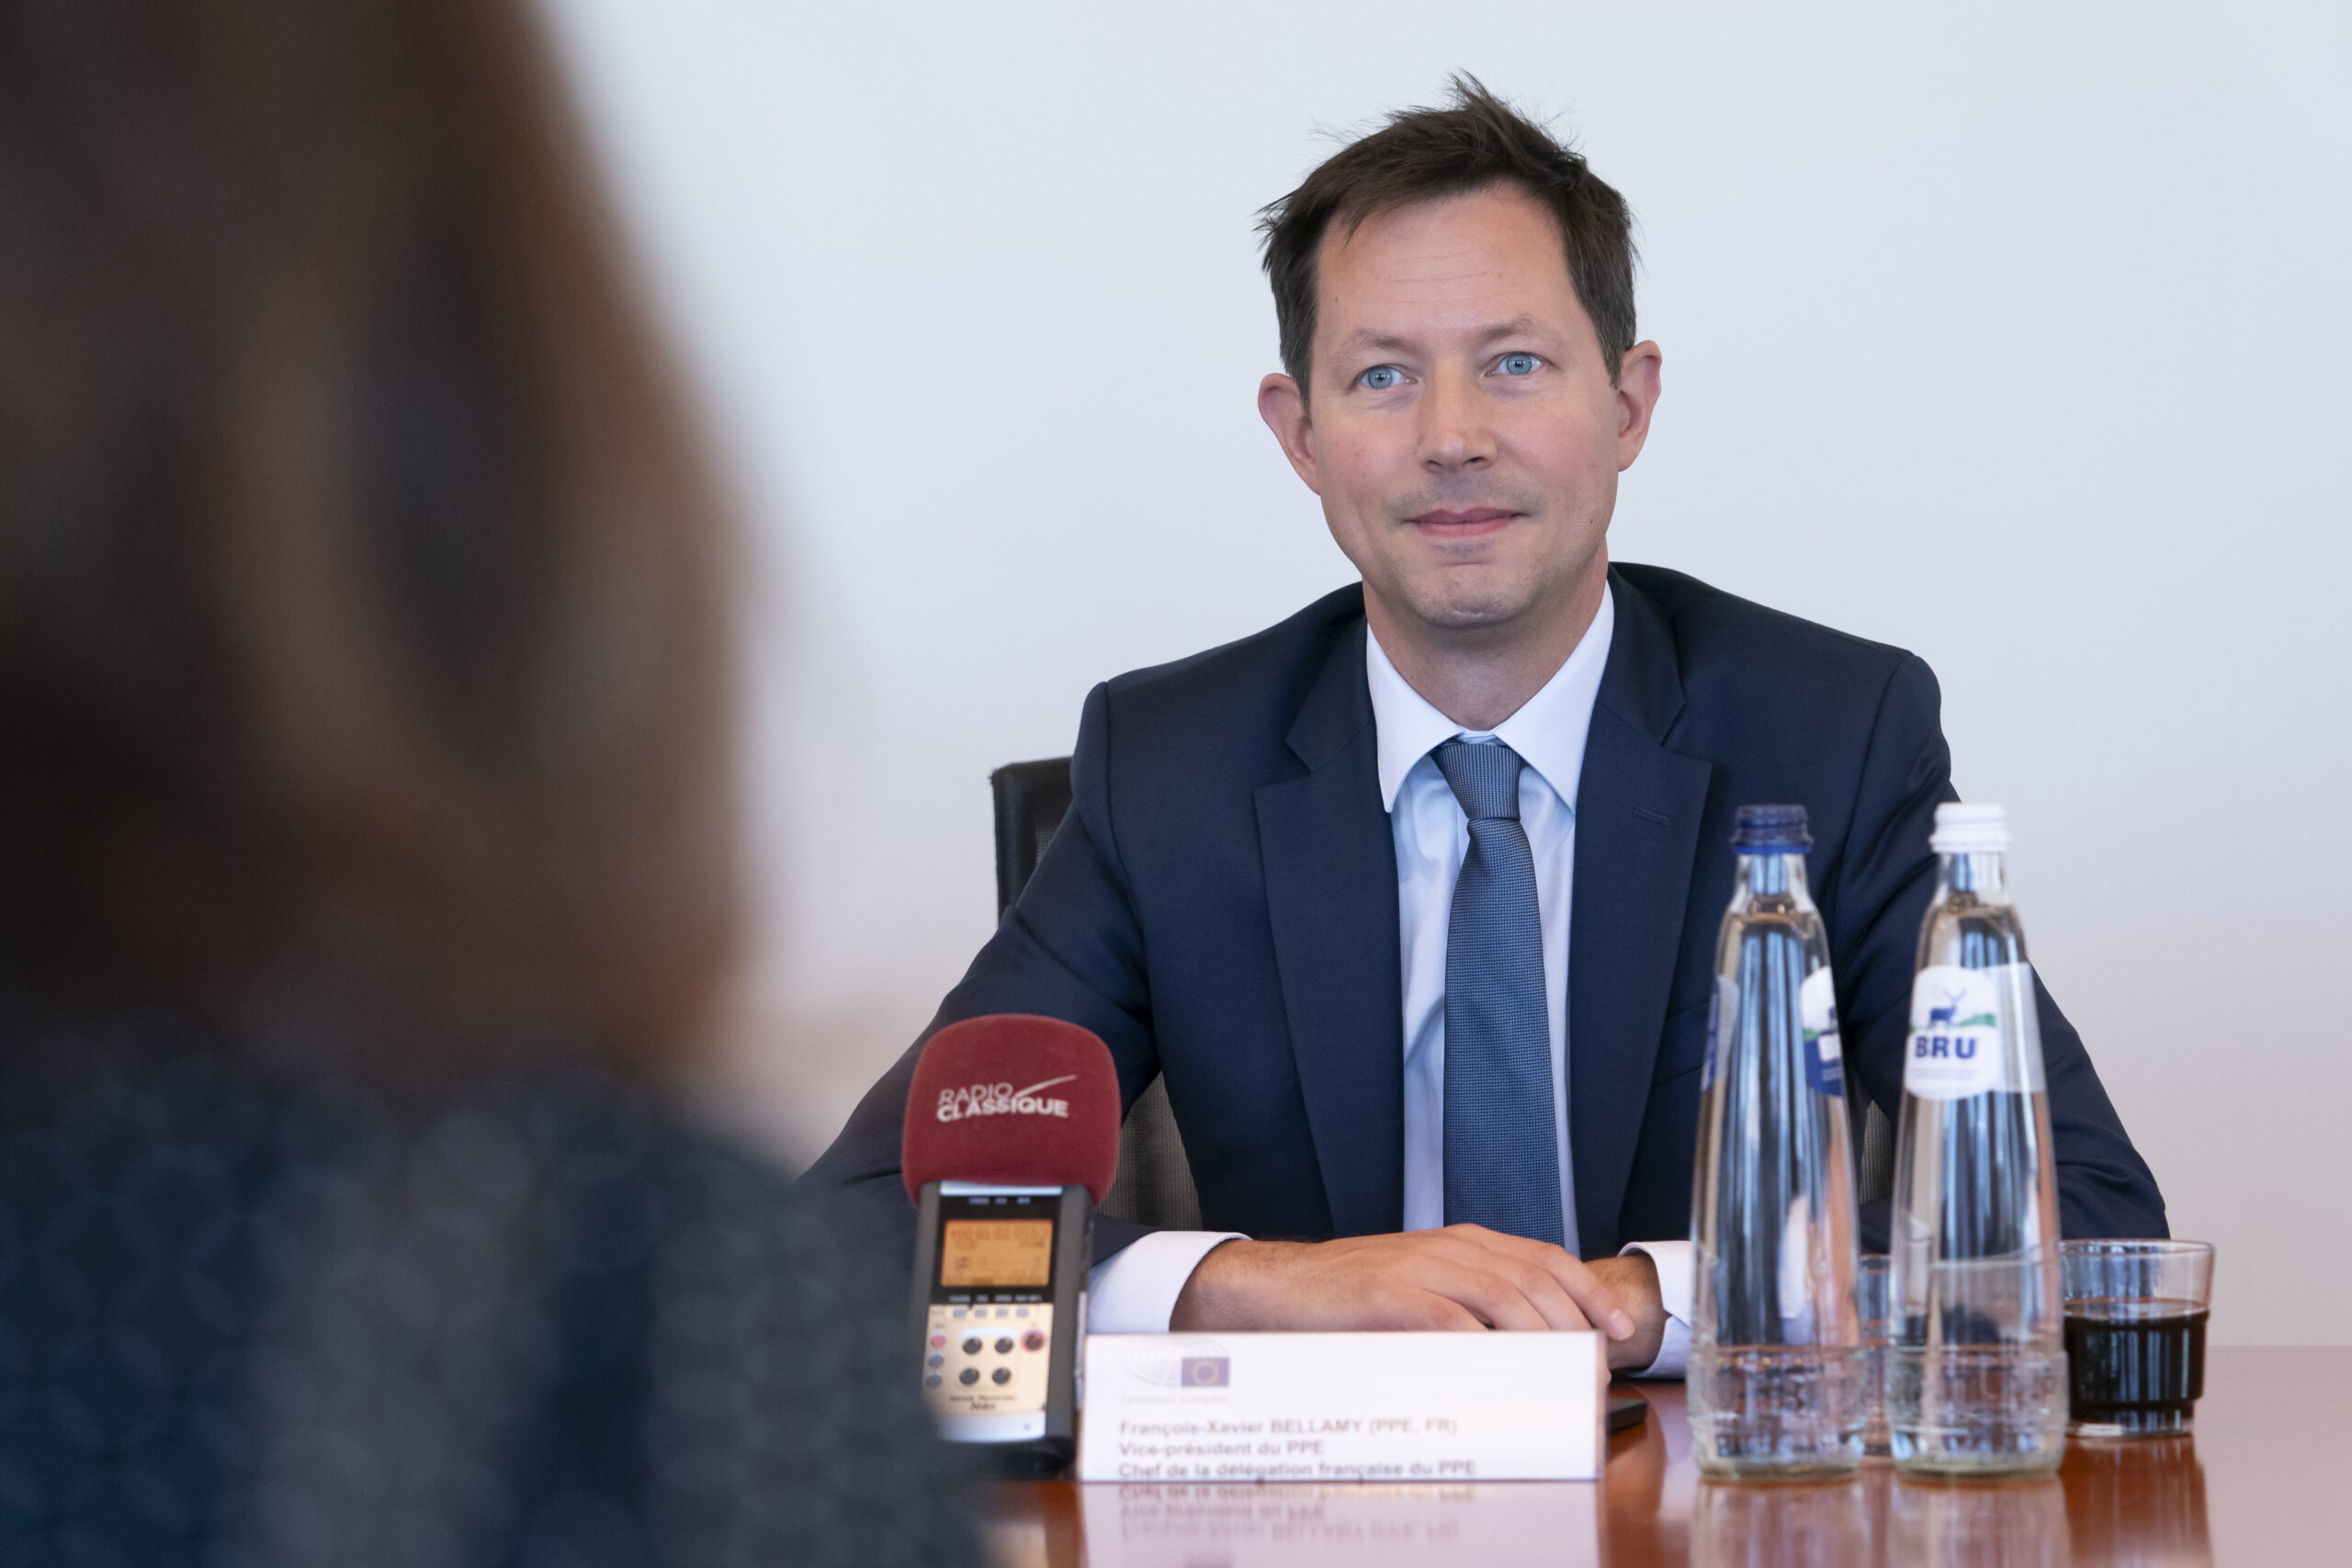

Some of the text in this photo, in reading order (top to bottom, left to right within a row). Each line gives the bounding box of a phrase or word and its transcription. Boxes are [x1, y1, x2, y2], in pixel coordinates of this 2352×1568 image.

[1915, 1036, 1976, 1059] BRU
[937, 1081, 1013, 1106] RADIO
[936, 1096, 1069, 1122] CLASSIQUE
[1119, 1419, 1263, 1437] François-Xavier
[1271, 1418, 1363, 1433] BELLAMY
[1425, 1418, 1457, 1435] FR)
[1119, 1440, 1325, 1457] Vice-président du PPE
[1118, 1460, 1476, 1479] Chef de la délégation française du PPE
